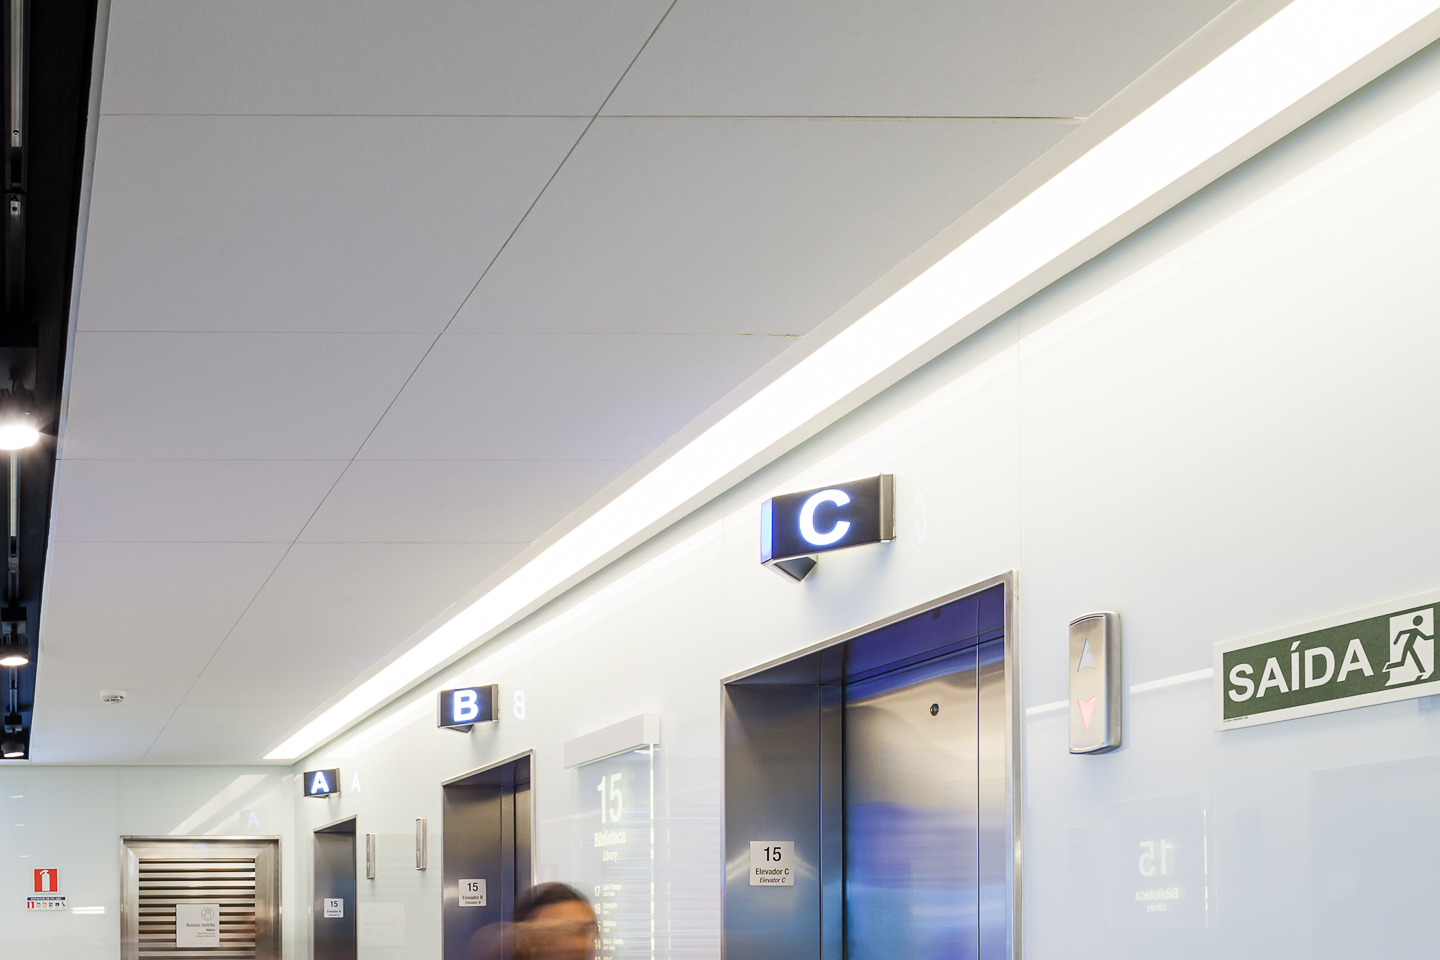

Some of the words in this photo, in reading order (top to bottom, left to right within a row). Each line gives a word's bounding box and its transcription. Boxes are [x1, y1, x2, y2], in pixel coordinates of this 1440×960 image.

[800, 489, 851, 546] C
[1228, 638, 1374, 703] SAÍDA
[453, 689, 479, 722] B
[311, 771, 329, 794] A
[597, 772, 623, 824] 15
[594, 830, 626, 848] Biblioteca
[763, 846, 782, 862] 15
[755, 867, 783, 876] Elevador
[784, 867, 790, 876] C
[467, 882, 479, 892] 15
[594, 885, 601, 897] 17
[330, 900, 338, 908] 15
